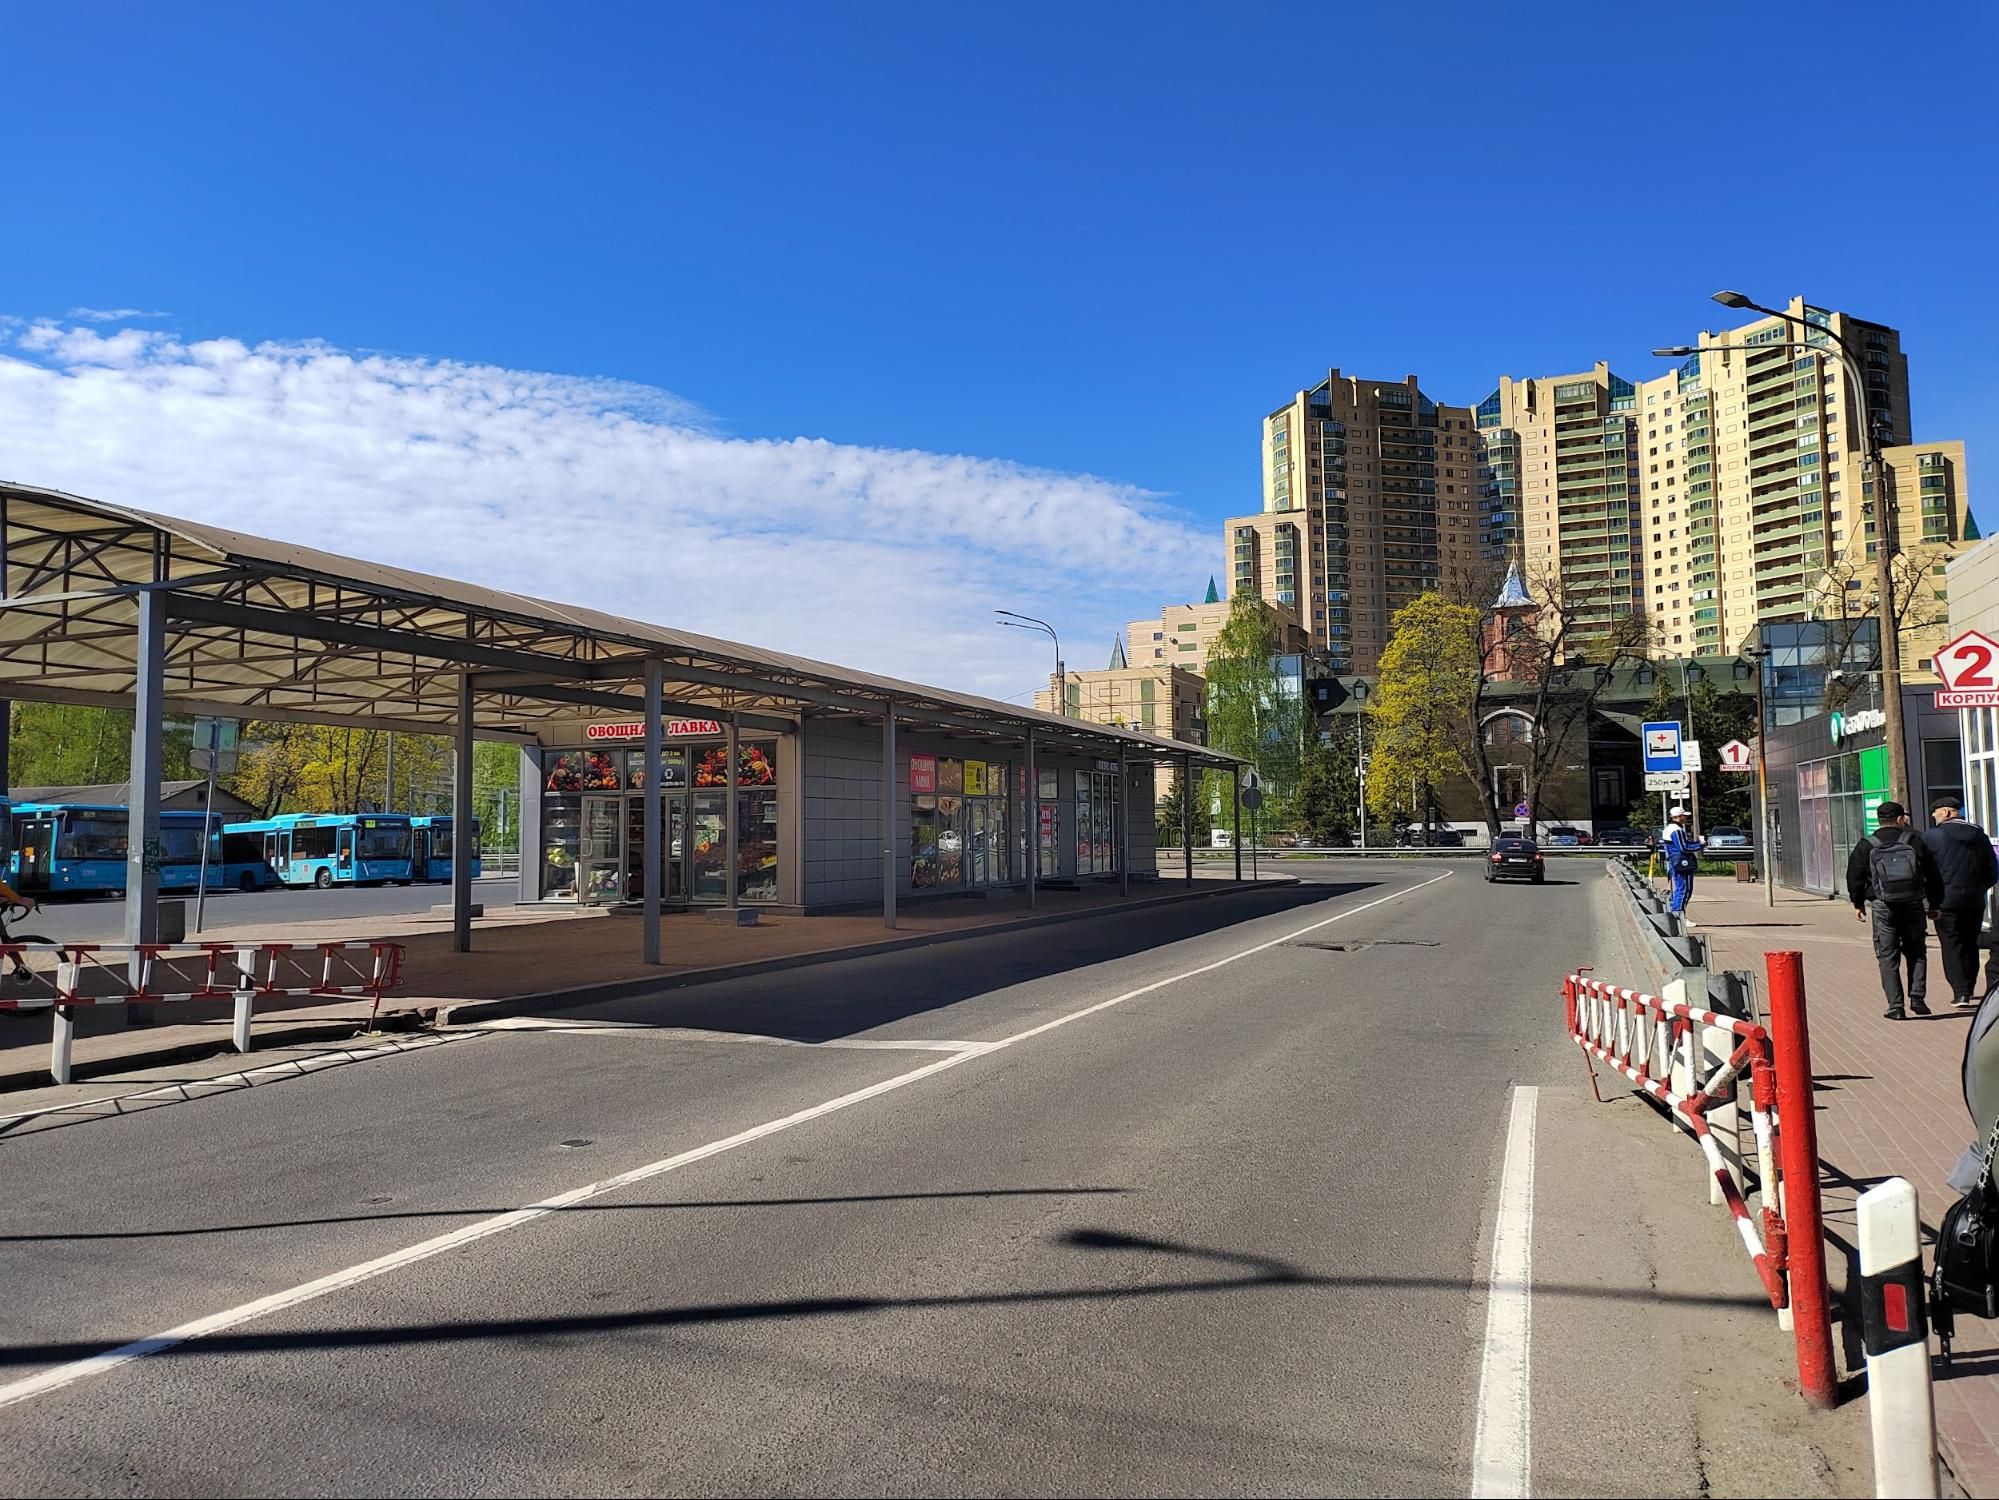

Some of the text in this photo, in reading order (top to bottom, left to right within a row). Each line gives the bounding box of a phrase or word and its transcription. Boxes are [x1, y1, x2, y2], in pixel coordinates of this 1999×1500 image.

[1953, 645, 1993, 687] 2
[1942, 694, 1999, 704] КОРПУ
[587, 720, 720, 739] ОВОЩНА ЛАВКА
[1728, 744, 1740, 763] 1
